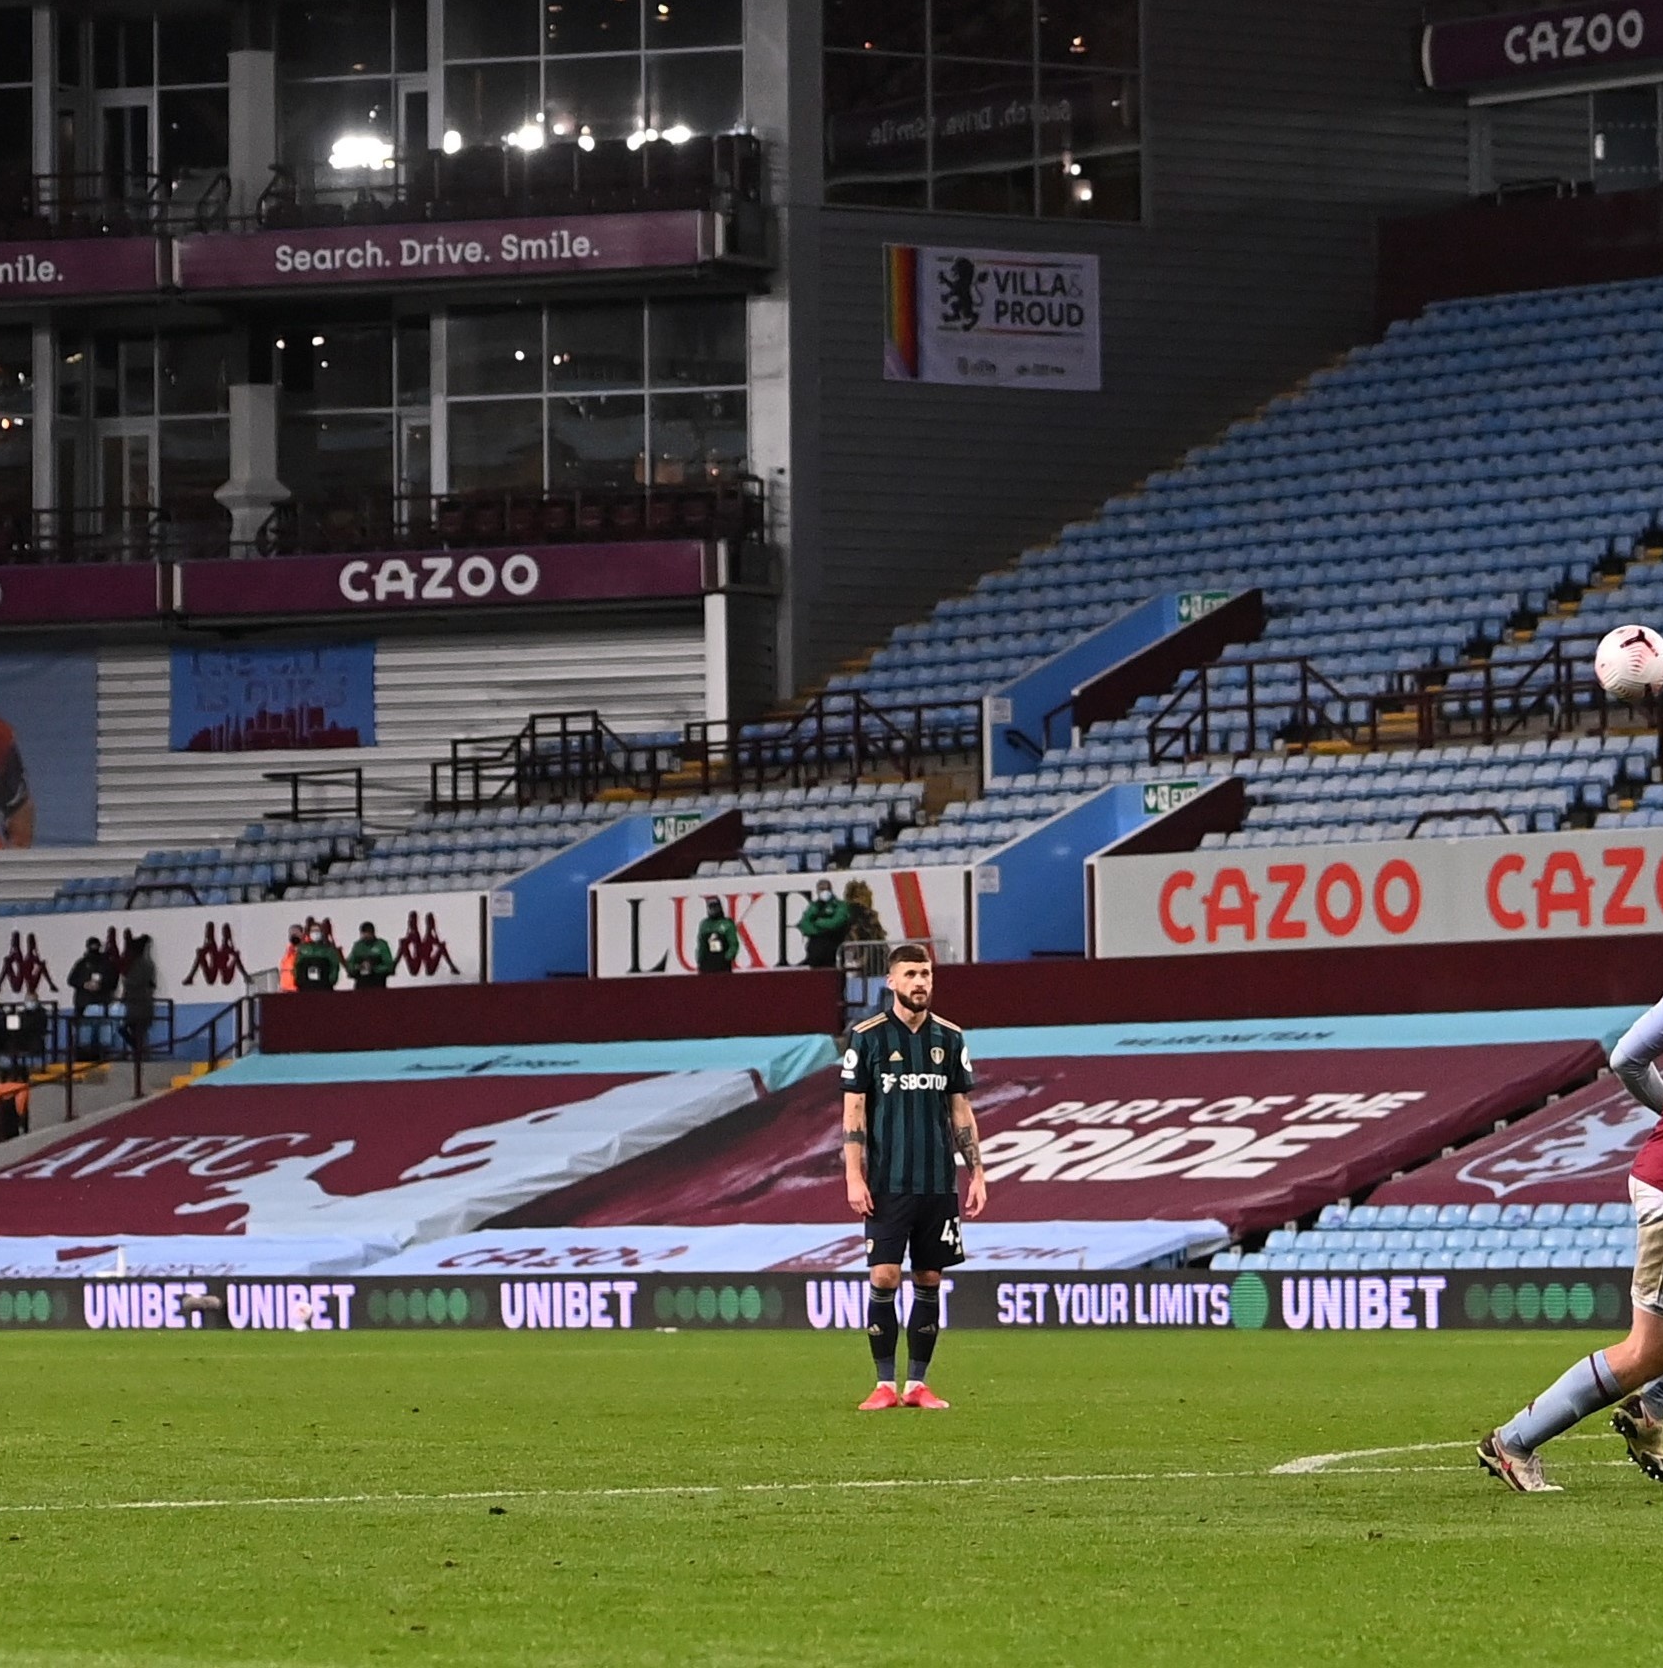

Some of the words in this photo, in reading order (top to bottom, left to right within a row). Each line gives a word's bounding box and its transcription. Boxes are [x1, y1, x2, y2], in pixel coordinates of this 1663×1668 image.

[1503, 9, 1644, 65] CAZOO
[275, 240, 390, 272] Search.
[400, 236, 491, 267] Drive.
[500, 230, 599, 262] Smile.
[994, 300, 1085, 327] PROUD
[339, 554, 539, 602] CAZOO
[1158, 859, 1422, 944] CAZOO
[1017, 1098, 1205, 1127] PART
[1187, 1095, 1296, 1125] OF
[1282, 1090, 1428, 1121] THE
[956, 1122, 1362, 1183] PRIDE
[83, 1283, 208, 1330] UNIBET
[227, 1283, 356, 1330] UNIBET
[500, 1281, 638, 1330] UNIBET
[997, 1283, 1039, 1325] SET
[1054, 1283, 1129, 1325] YOUR
[1135, 1282, 1232, 1325] LIMITS
[1281, 1276, 1447, 1330] UNIBET
